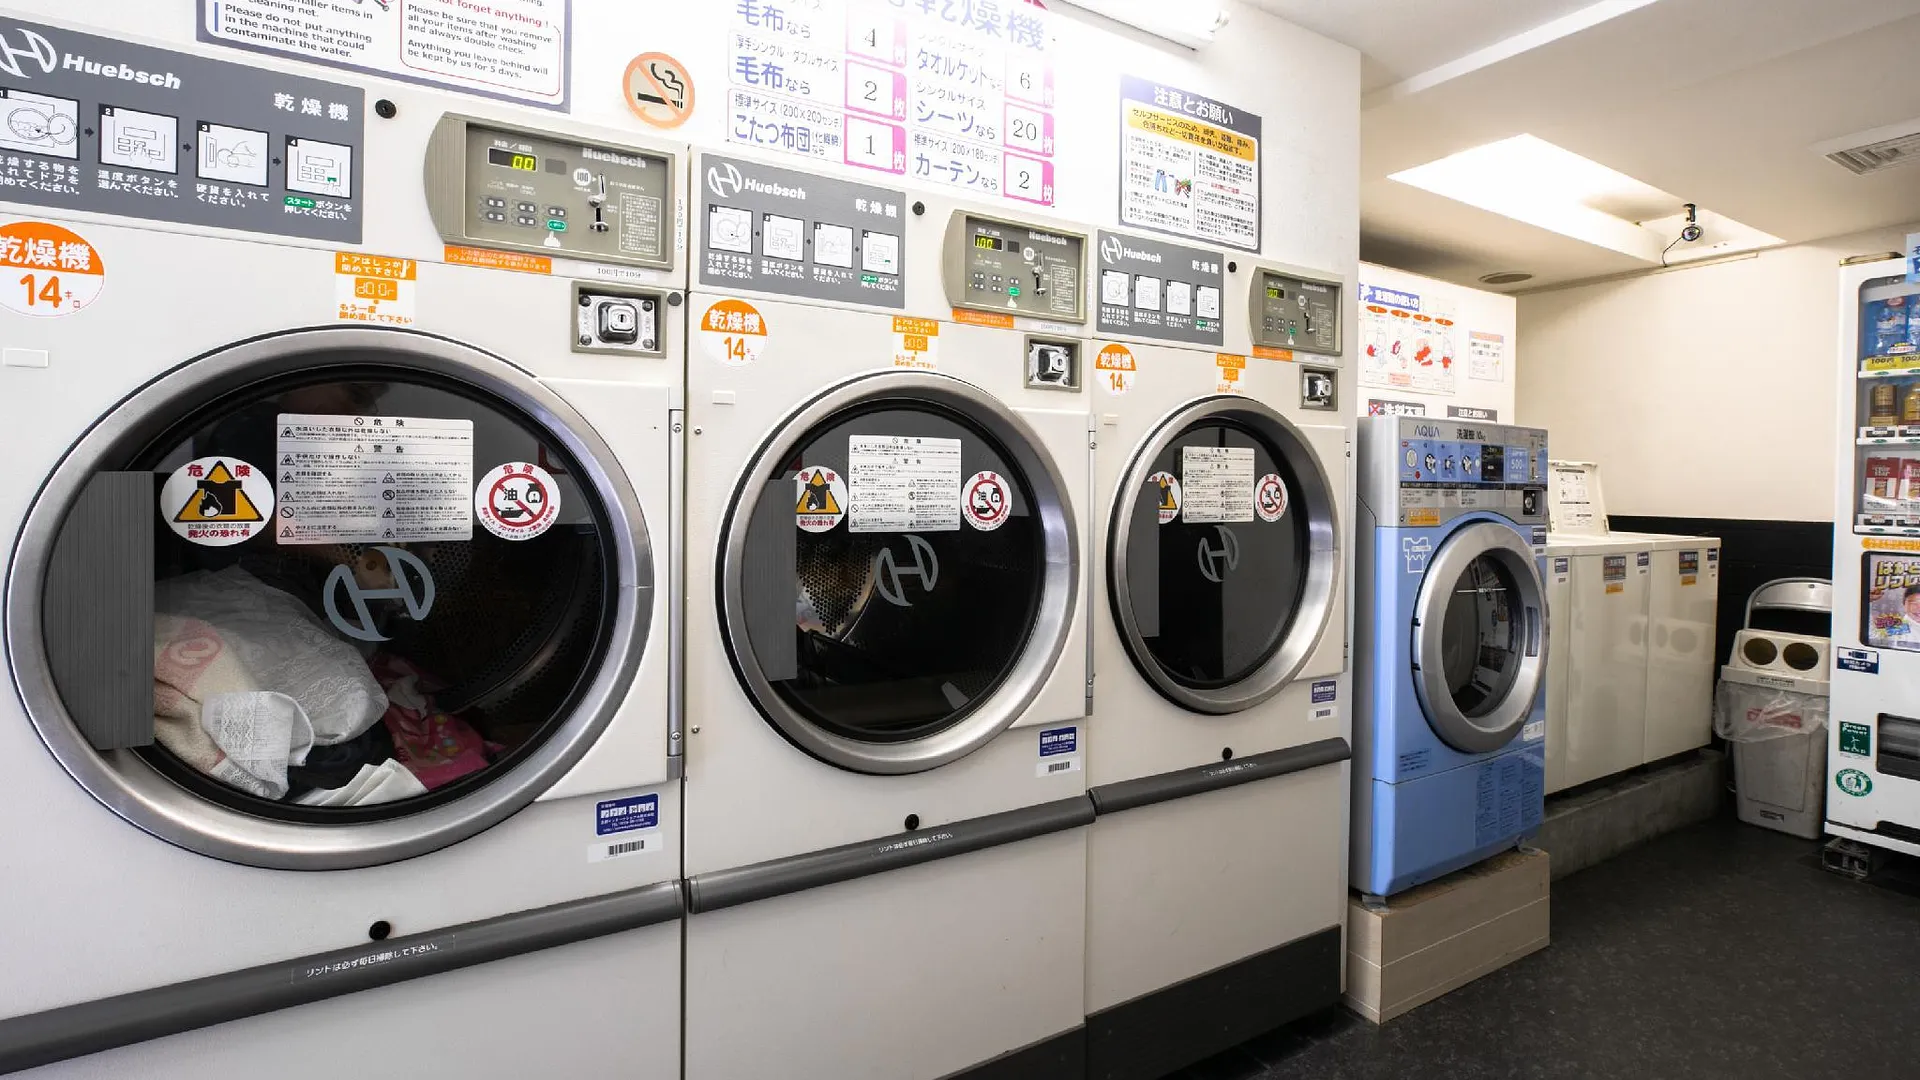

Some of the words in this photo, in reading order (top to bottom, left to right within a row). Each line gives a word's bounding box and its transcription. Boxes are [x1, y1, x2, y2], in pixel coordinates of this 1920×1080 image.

[298, 6, 319, 18] net.
[331, 4, 360, 17] items
[364, 8, 373, 20] in
[457, 0, 492, 15] forget
[494, 8, 542, 28] anything
[224, 14, 236, 24] in
[240, 17, 258, 28] the
[262, 22, 308, 39] machine
[311, 33, 334, 45] that
[336, 37, 365, 50] could
[225, 4, 262, 19] Please
[266, 13, 280, 22] do
[283, 18, 301, 28] not
[305, 21, 324, 34] put
[326, 26, 372, 43] anything
[408, 3, 440, 18] Please
[442, 11, 454, 21] be
[456, 15, 477, 26] sure
[479, 20, 498, 32] that
[501, 26, 518, 38] you
[520, 30, 552, 44] remove
[408, 13, 420, 23] all
[422, 16, 444, 30] your
[447, 22, 473, 34] items
[476, 28, 498, 40] after
[500, 34, 537, 50] washing
[224, 26, 296, 47] contaminate
[299, 38, 317, 51] the
[320, 44, 352, 58] water.
[408, 22, 426, 34] and
[428, 27, 462, 42] always
[464, 35, 496, 49] double
[498, 42, 526, 56] check.
[408, 38, 451, 55] Anything
[454, 48, 471, 60] you
[474, 52, 498, 65] leave
[500, 57, 530, 72] behind
[532, 64, 548, 76] will
[408, 48, 420, 58] be
[422, 50, 444, 64] kept
[446, 56, 458, 67] by
[460, 59, 472, 68] us
[474, 62, 488, 72] for
[490, 66, 496, 74] 5
[498, 68, 523, 80] days.
[62, 53, 182, 90] Huebsch
[736, 55, 811, 95] 毛布なら
[1020, 72, 1030, 90] 6
[864, 80, 877, 102] 2
[274, 92, 349, 122] 乾燥機
[1154, 86, 1234, 126] 注意とお願い
[1012, 118, 1036, 141] 20
[866, 135, 876, 156] 1
[582, 147, 646, 169] Huebsch
[98, 169, 178, 188] 温度ボタンを
[98, 178, 178, 198] 選んでください。
[744, 178, 806, 200] Huebsch
[1018, 170, 1030, 190] 2
[196, 183, 270, 202] 硬貨を入れて
[196, 193, 246, 208] ください。
[0, 235, 90, 271] 乾燥機
[1123, 247, 1162, 264] Huebsch
[20, 274, 62, 308] 14
[709, 309, 760, 333] 乾燥機
[724, 336, 746, 361] 14
[1110, 372, 1123, 392] 14
[1414, 424, 1440, 438] AQUA
[187, 464, 251, 478] 危険
[503, 464, 534, 475] 危険
[504, 488, 518, 501] 油
[188, 530, 250, 538] 発火の恐れ有
